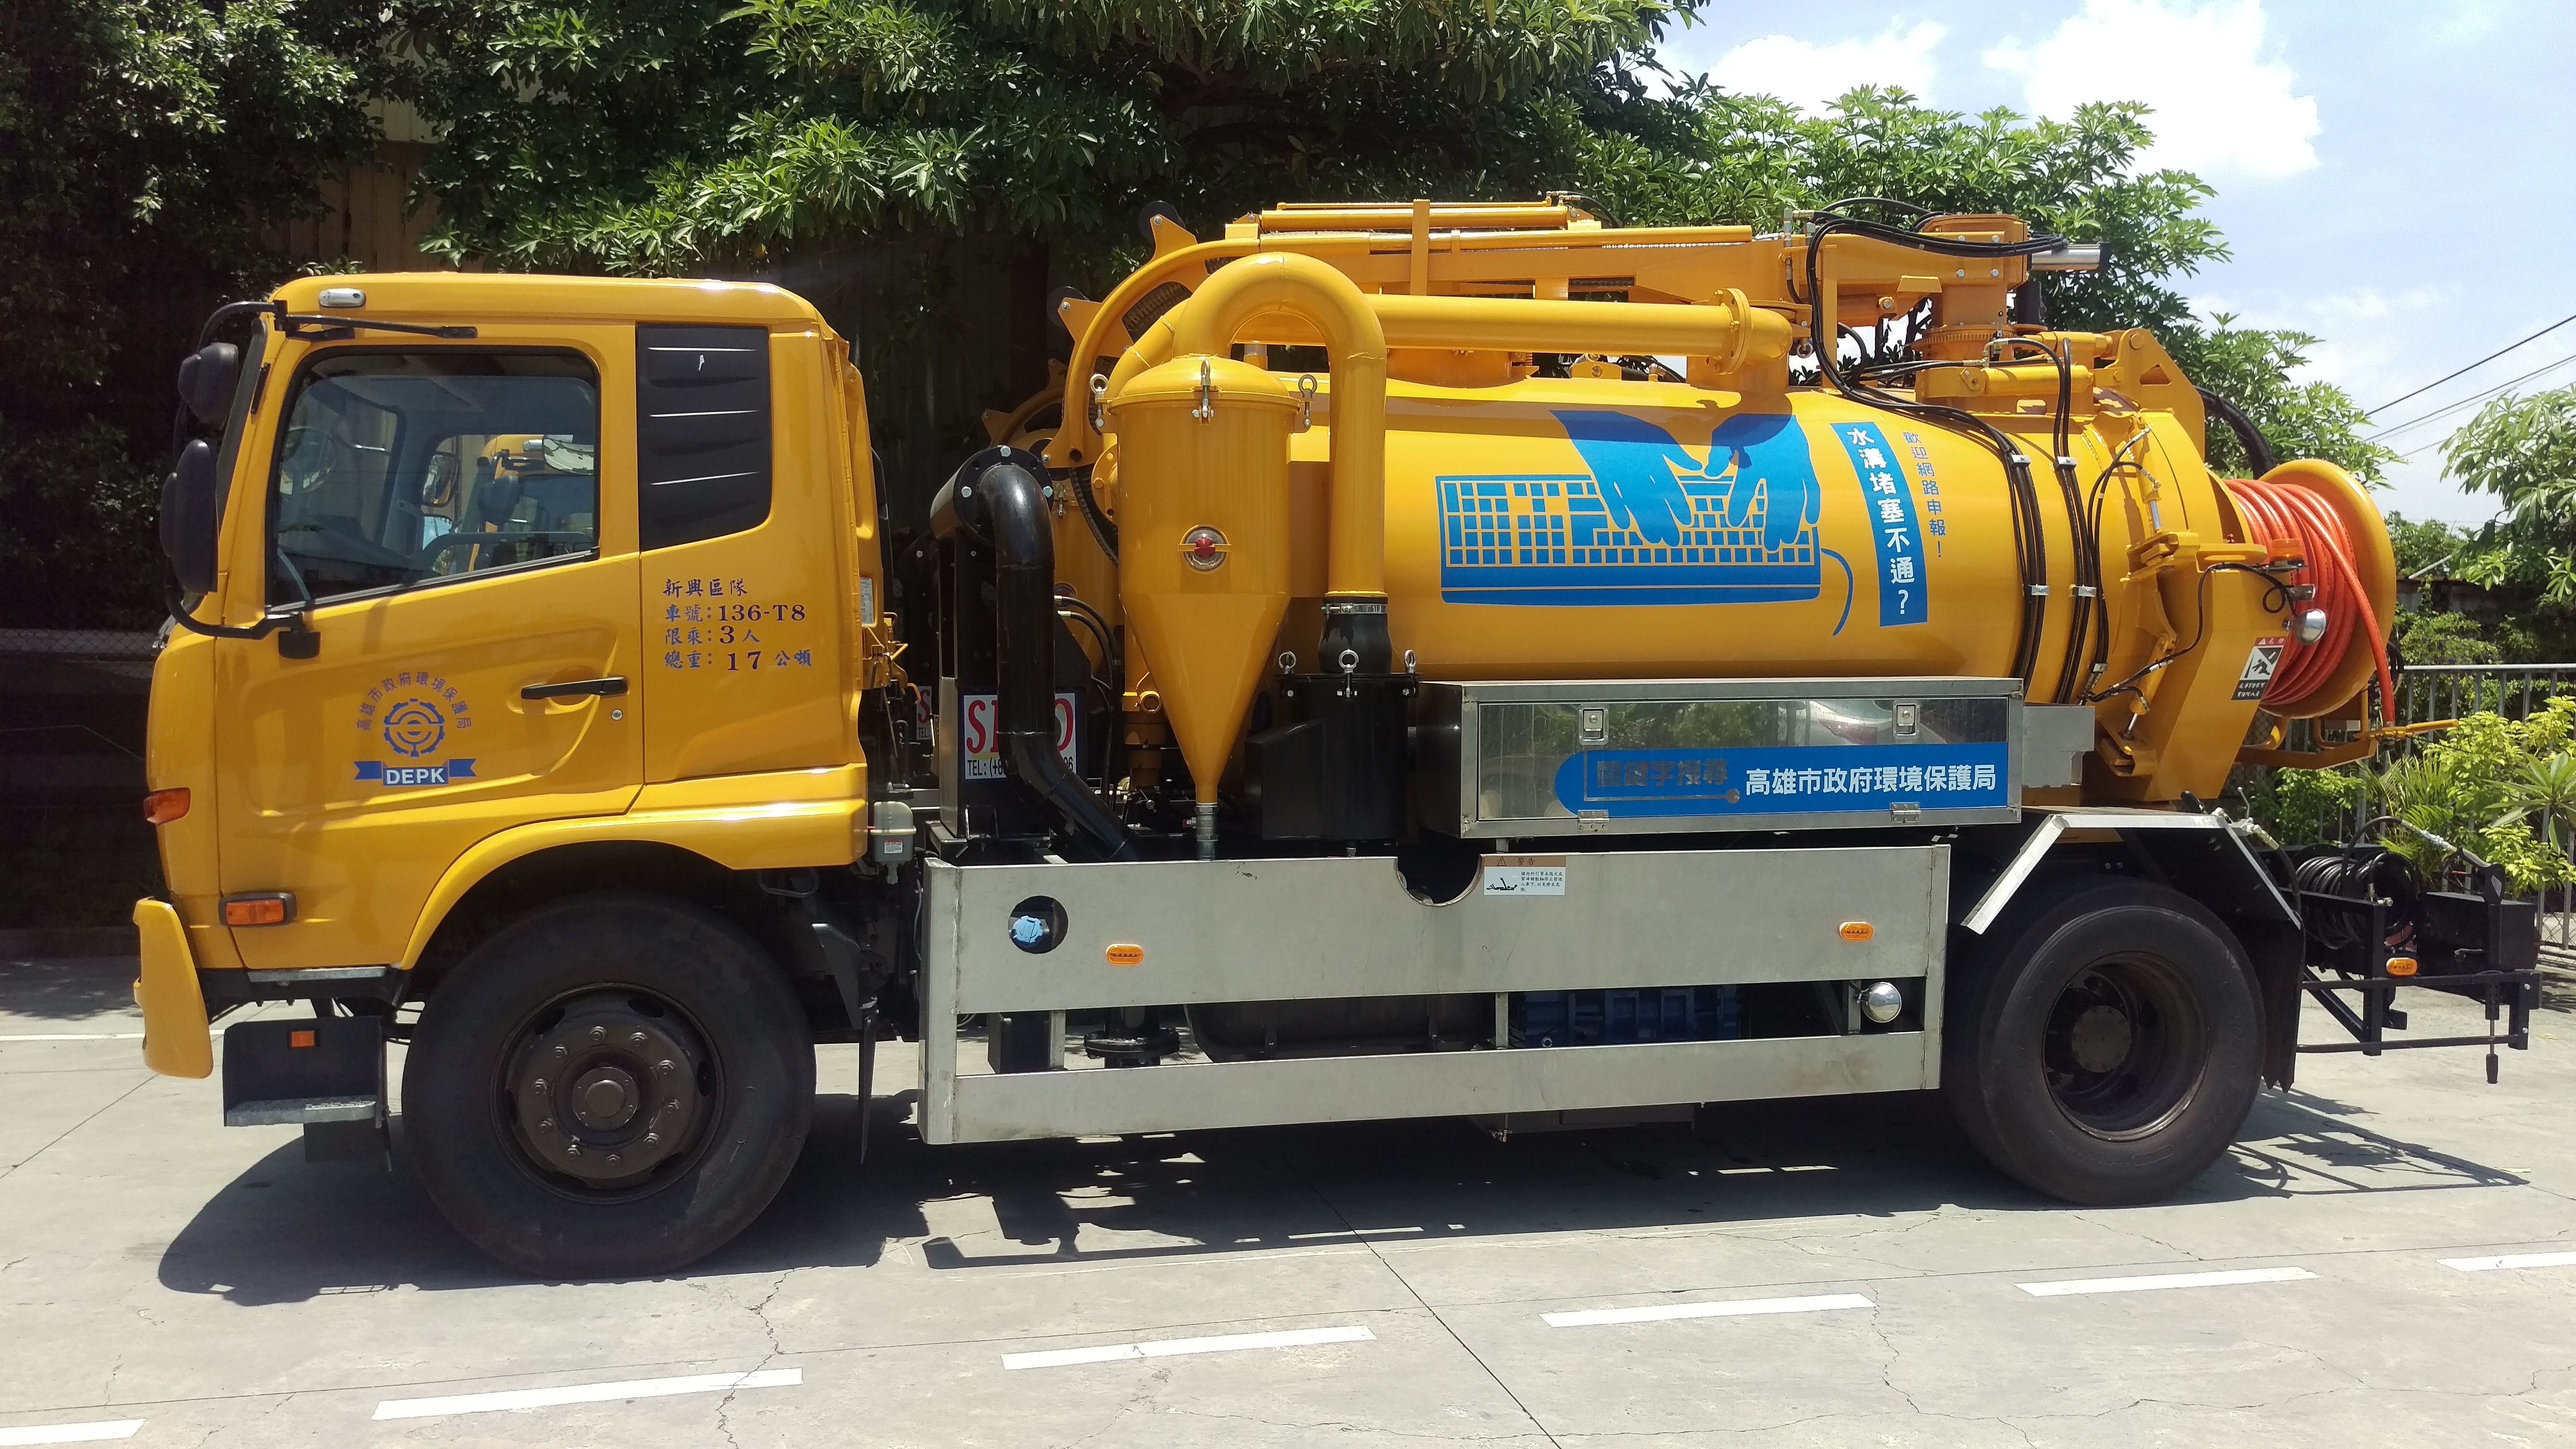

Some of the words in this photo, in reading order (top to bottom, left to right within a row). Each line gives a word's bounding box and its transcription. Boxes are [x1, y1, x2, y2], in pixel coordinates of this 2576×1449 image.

[663, 578, 748, 598] 新興區隊
[386, 768, 445, 785] DEPK
[1746, 764, 1996, 795] 高雄市政府環境保護局
